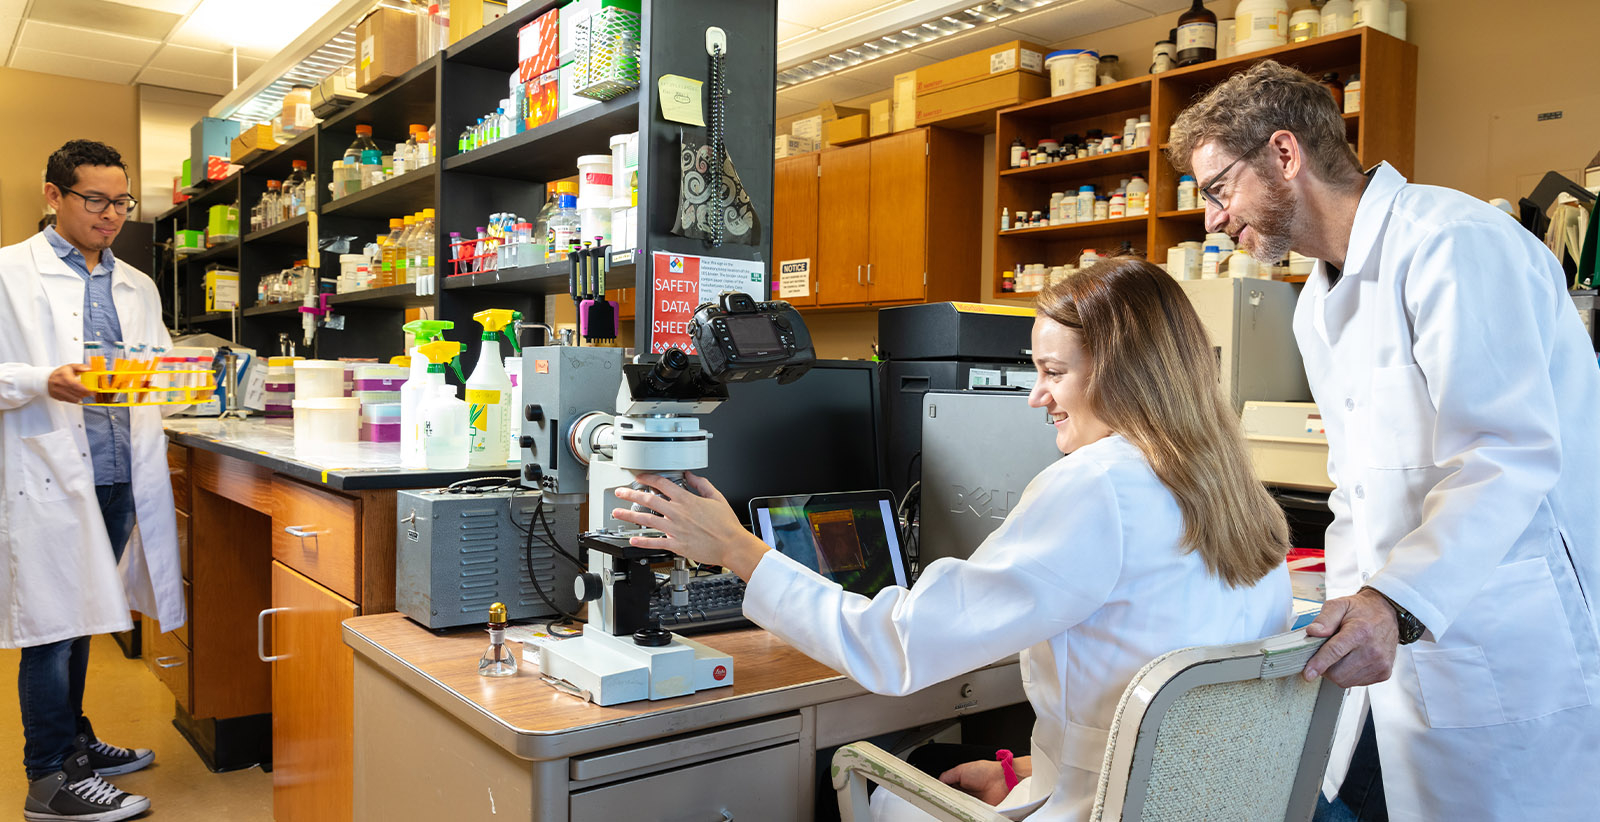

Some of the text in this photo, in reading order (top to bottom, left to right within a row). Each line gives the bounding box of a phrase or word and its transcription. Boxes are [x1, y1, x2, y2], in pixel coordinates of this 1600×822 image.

[783, 263, 806, 273] NOTICE
[655, 278, 698, 293] SAFETY
[661, 300, 691, 314] DATA
